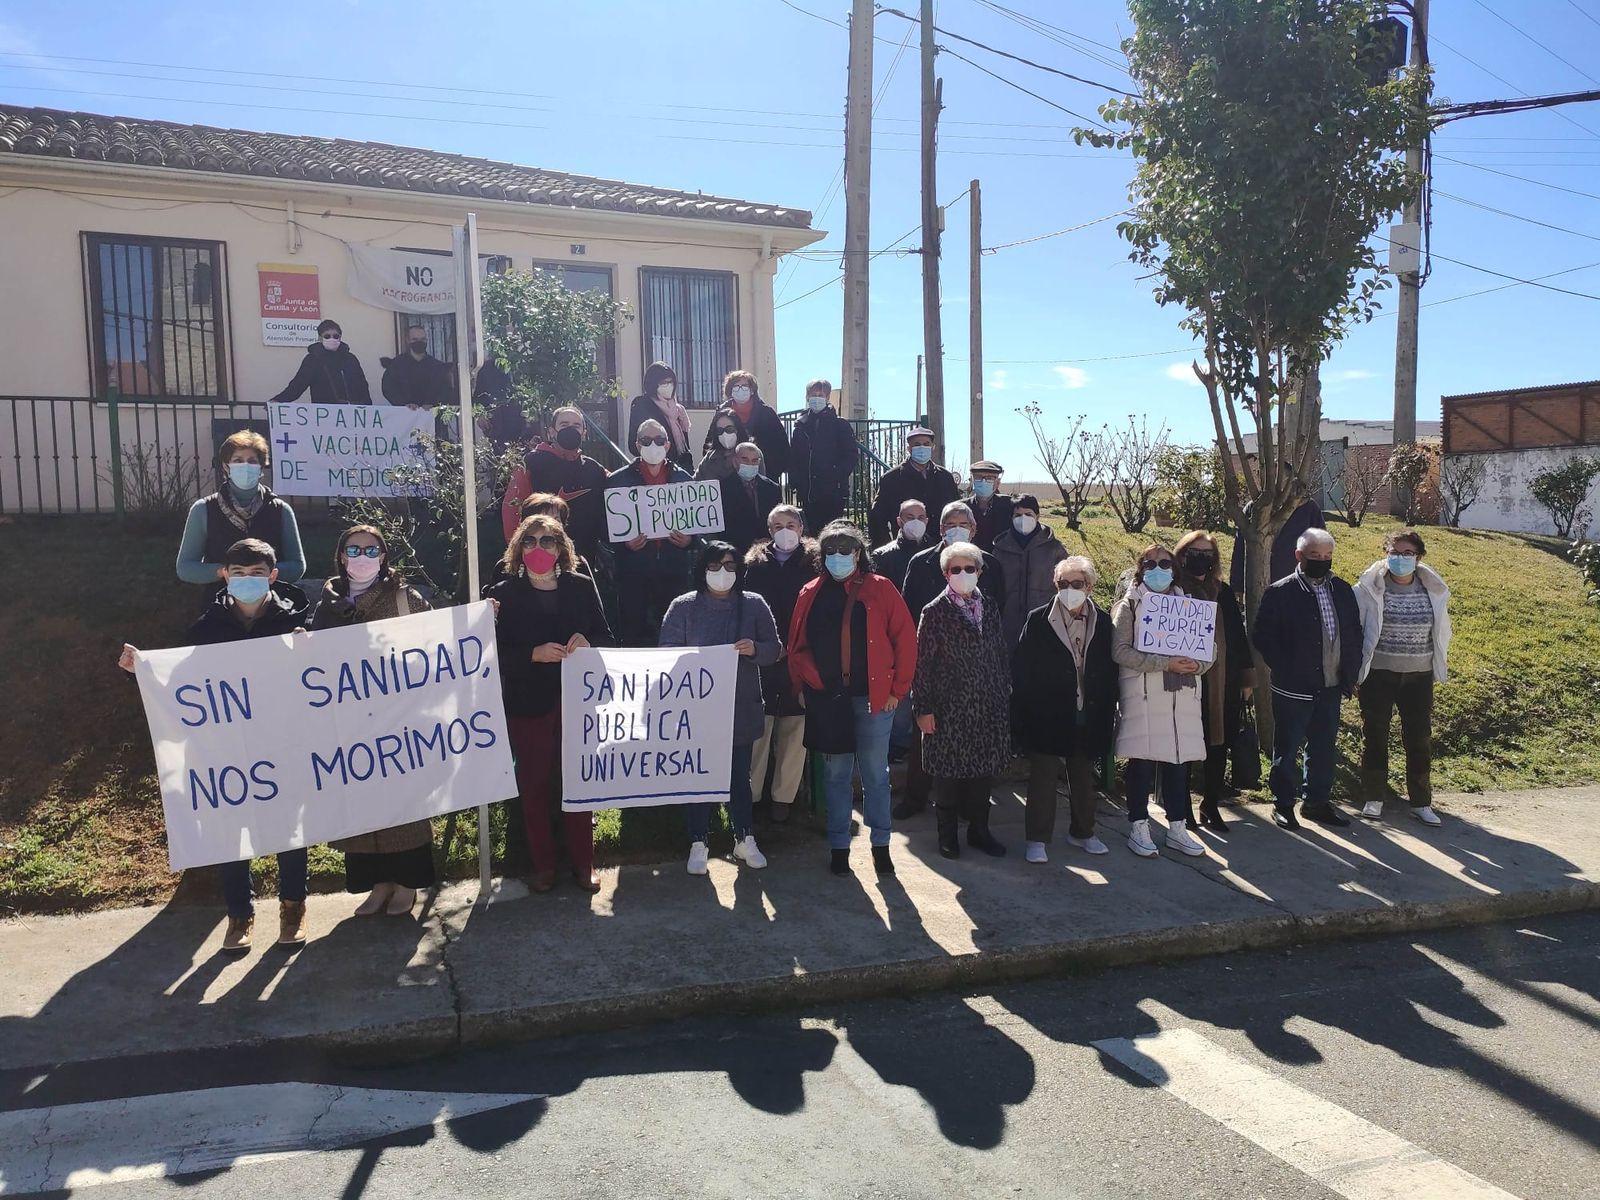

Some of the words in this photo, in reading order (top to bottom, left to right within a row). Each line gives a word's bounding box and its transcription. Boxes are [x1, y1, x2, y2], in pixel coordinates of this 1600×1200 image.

[406, 266, 433, 287] NO
[263, 304, 290, 312] Castilla
[284, 298, 305, 306] Junta
[265, 322, 319, 332] Consultorio
[311, 433, 400, 457] VACIADA
[280, 460, 308, 481] DE
[646, 485, 719, 507] SANIDAD
[652, 504, 719, 533] PÚBLICA
[1147, 594, 1213, 621] SANIDAD
[1158, 615, 1206, 638] RURAL
[1143, 630, 1207, 655] DIGNA
[175, 677, 252, 727] SIN
[301, 635, 490, 708] SANIDAD,
[583, 668, 715, 702] SANIDAD
[583, 708, 691, 745] PÚBLICA
[189, 760, 279, 811] NOS
[311, 710, 497, 791] MORIMOS
[581, 747, 710, 783] UNIVERSAL
